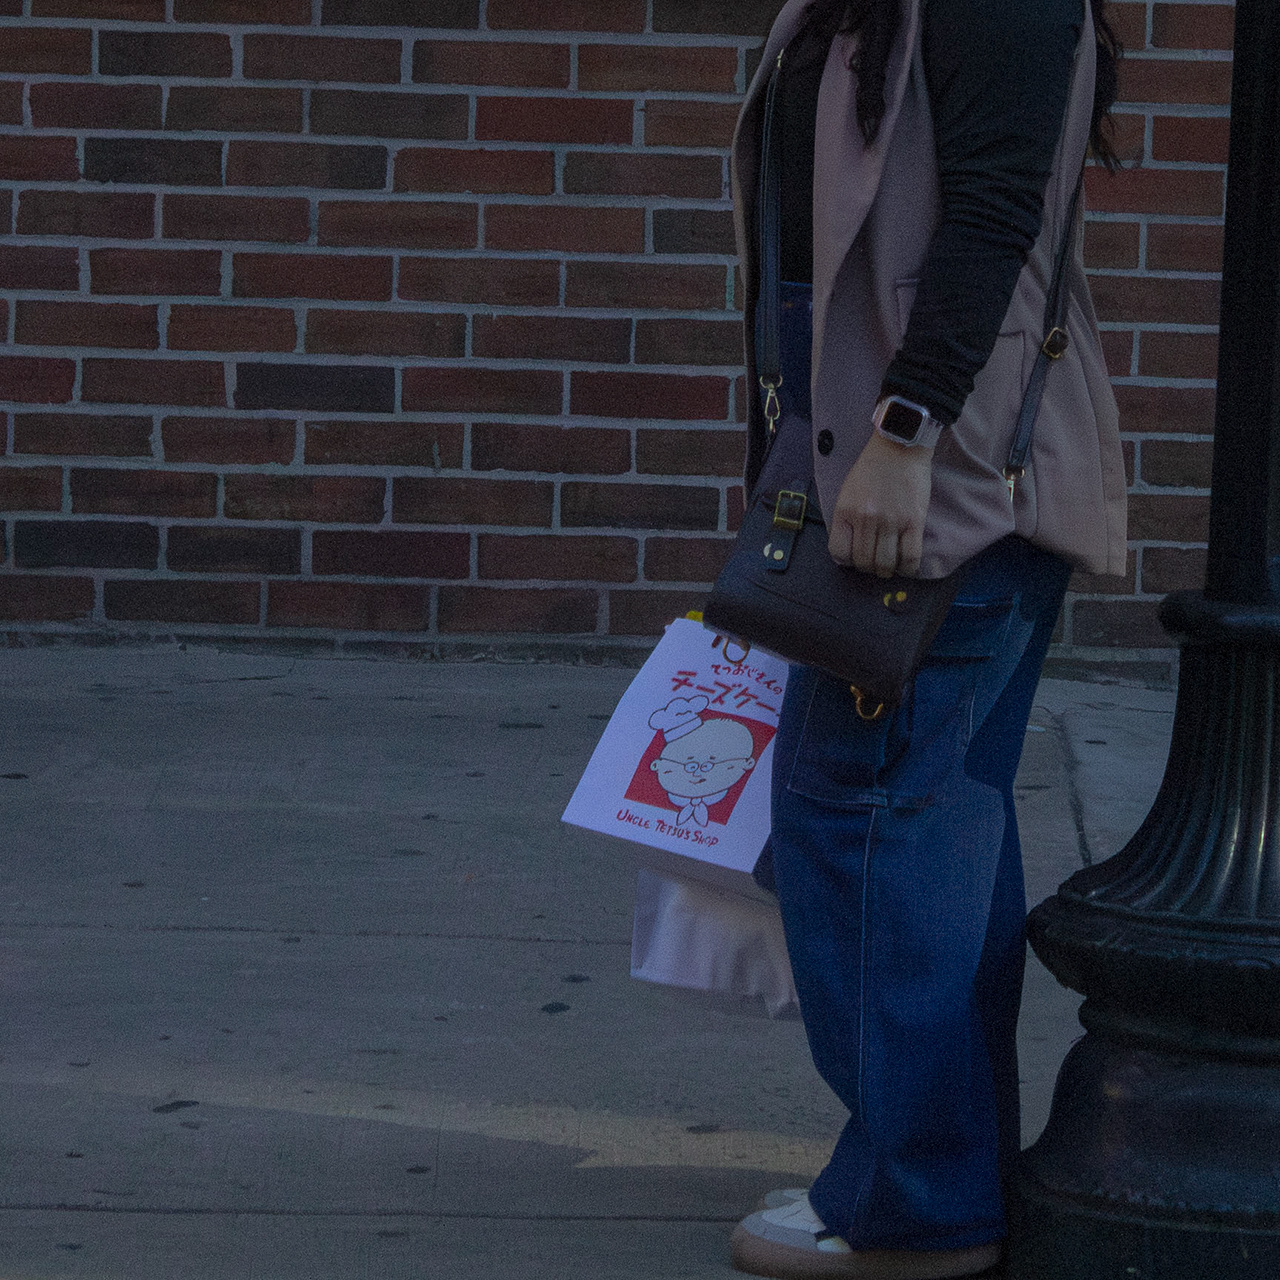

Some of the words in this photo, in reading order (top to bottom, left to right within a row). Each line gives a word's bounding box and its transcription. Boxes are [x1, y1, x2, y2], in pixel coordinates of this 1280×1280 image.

[672, 670, 781, 717] チーズケー
[616, 809, 651, 829] UNCLE
[691, 830, 719, 847] SHOP
